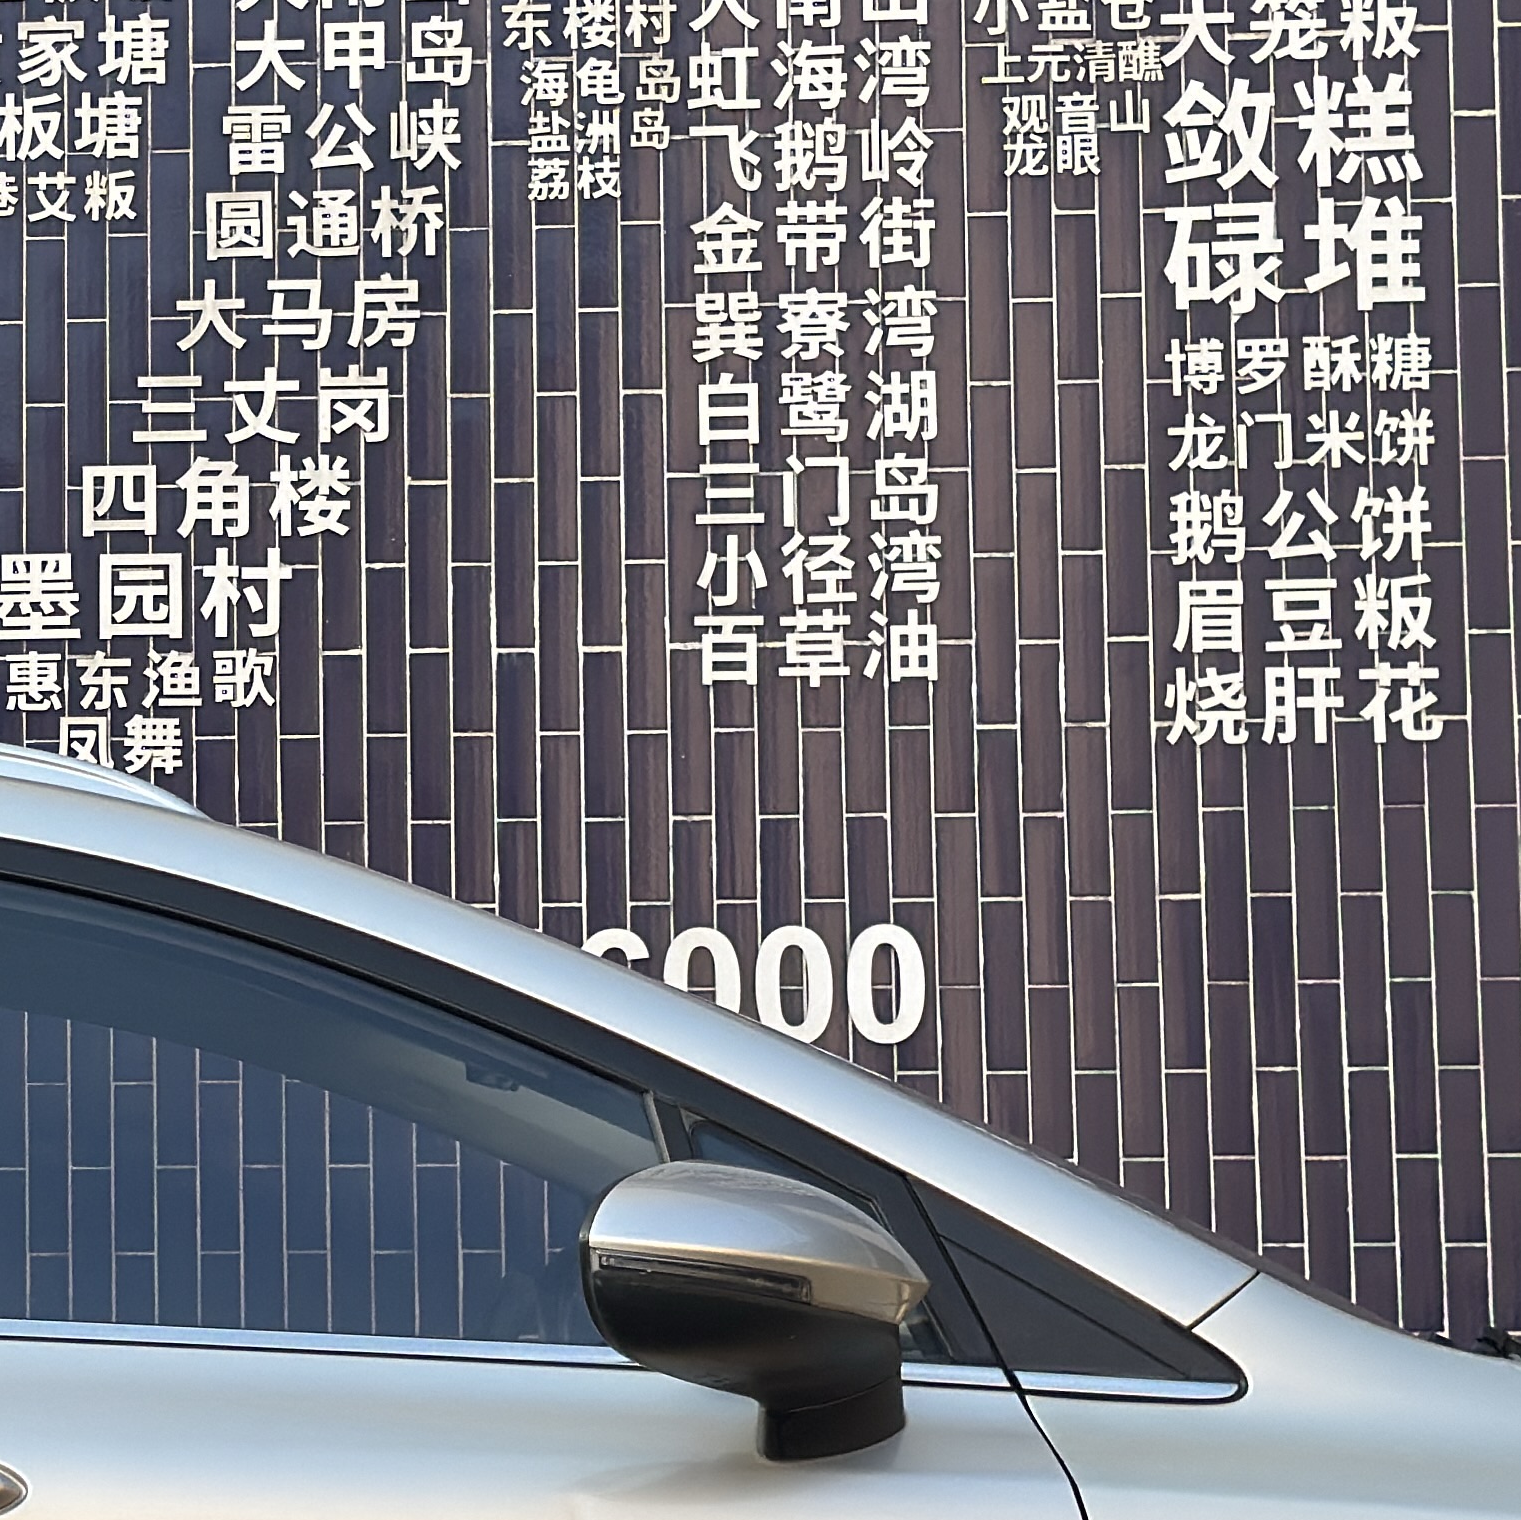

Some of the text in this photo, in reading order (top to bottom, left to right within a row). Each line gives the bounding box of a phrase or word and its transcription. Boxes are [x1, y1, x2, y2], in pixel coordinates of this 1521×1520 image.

[235, 15, 473, 91] 大甲岛
[520, 57, 680, 106] 海龟岛
[223, 98, 462, 175] 雷公峡
[528, 107, 670, 155] 盐洲岛
[1002, 90, 1150, 135] 观音山
[528, 155, 621, 201] 荔枝
[689, 116, 933, 192] 飞鹅岭
[1003, 133, 1101, 176] 龙眼
[205, 184, 444, 261] 圆通桥
[690, 196, 935, 273] 金带街
[1164, 196, 1425, 315] 碌堆
[176, 272, 421, 351] 大马房
[692, 284, 938, 363] 巽寮湾
[1164, 333, 1431, 396] 博罗酥糖
[132, 364, 390, 444] 三丈岗
[697, 370, 937, 447] 白鹭湖
[1168, 408, 1435, 471] 龙门米饼
[82, 454, 351, 539] 四角楼
[695, 452, 939, 528] 三门岛
[1169, 485, 1431, 565] 鹅公饼
[696, 529, 942, 607] 小径湾
[6, 648, 275, 712] 惠东渔歌
[694, 609, 939, 688] 百草油
[1164, 662, 1442, 745] 烧肝花
[59, 714, 183, 775] 凤舞
